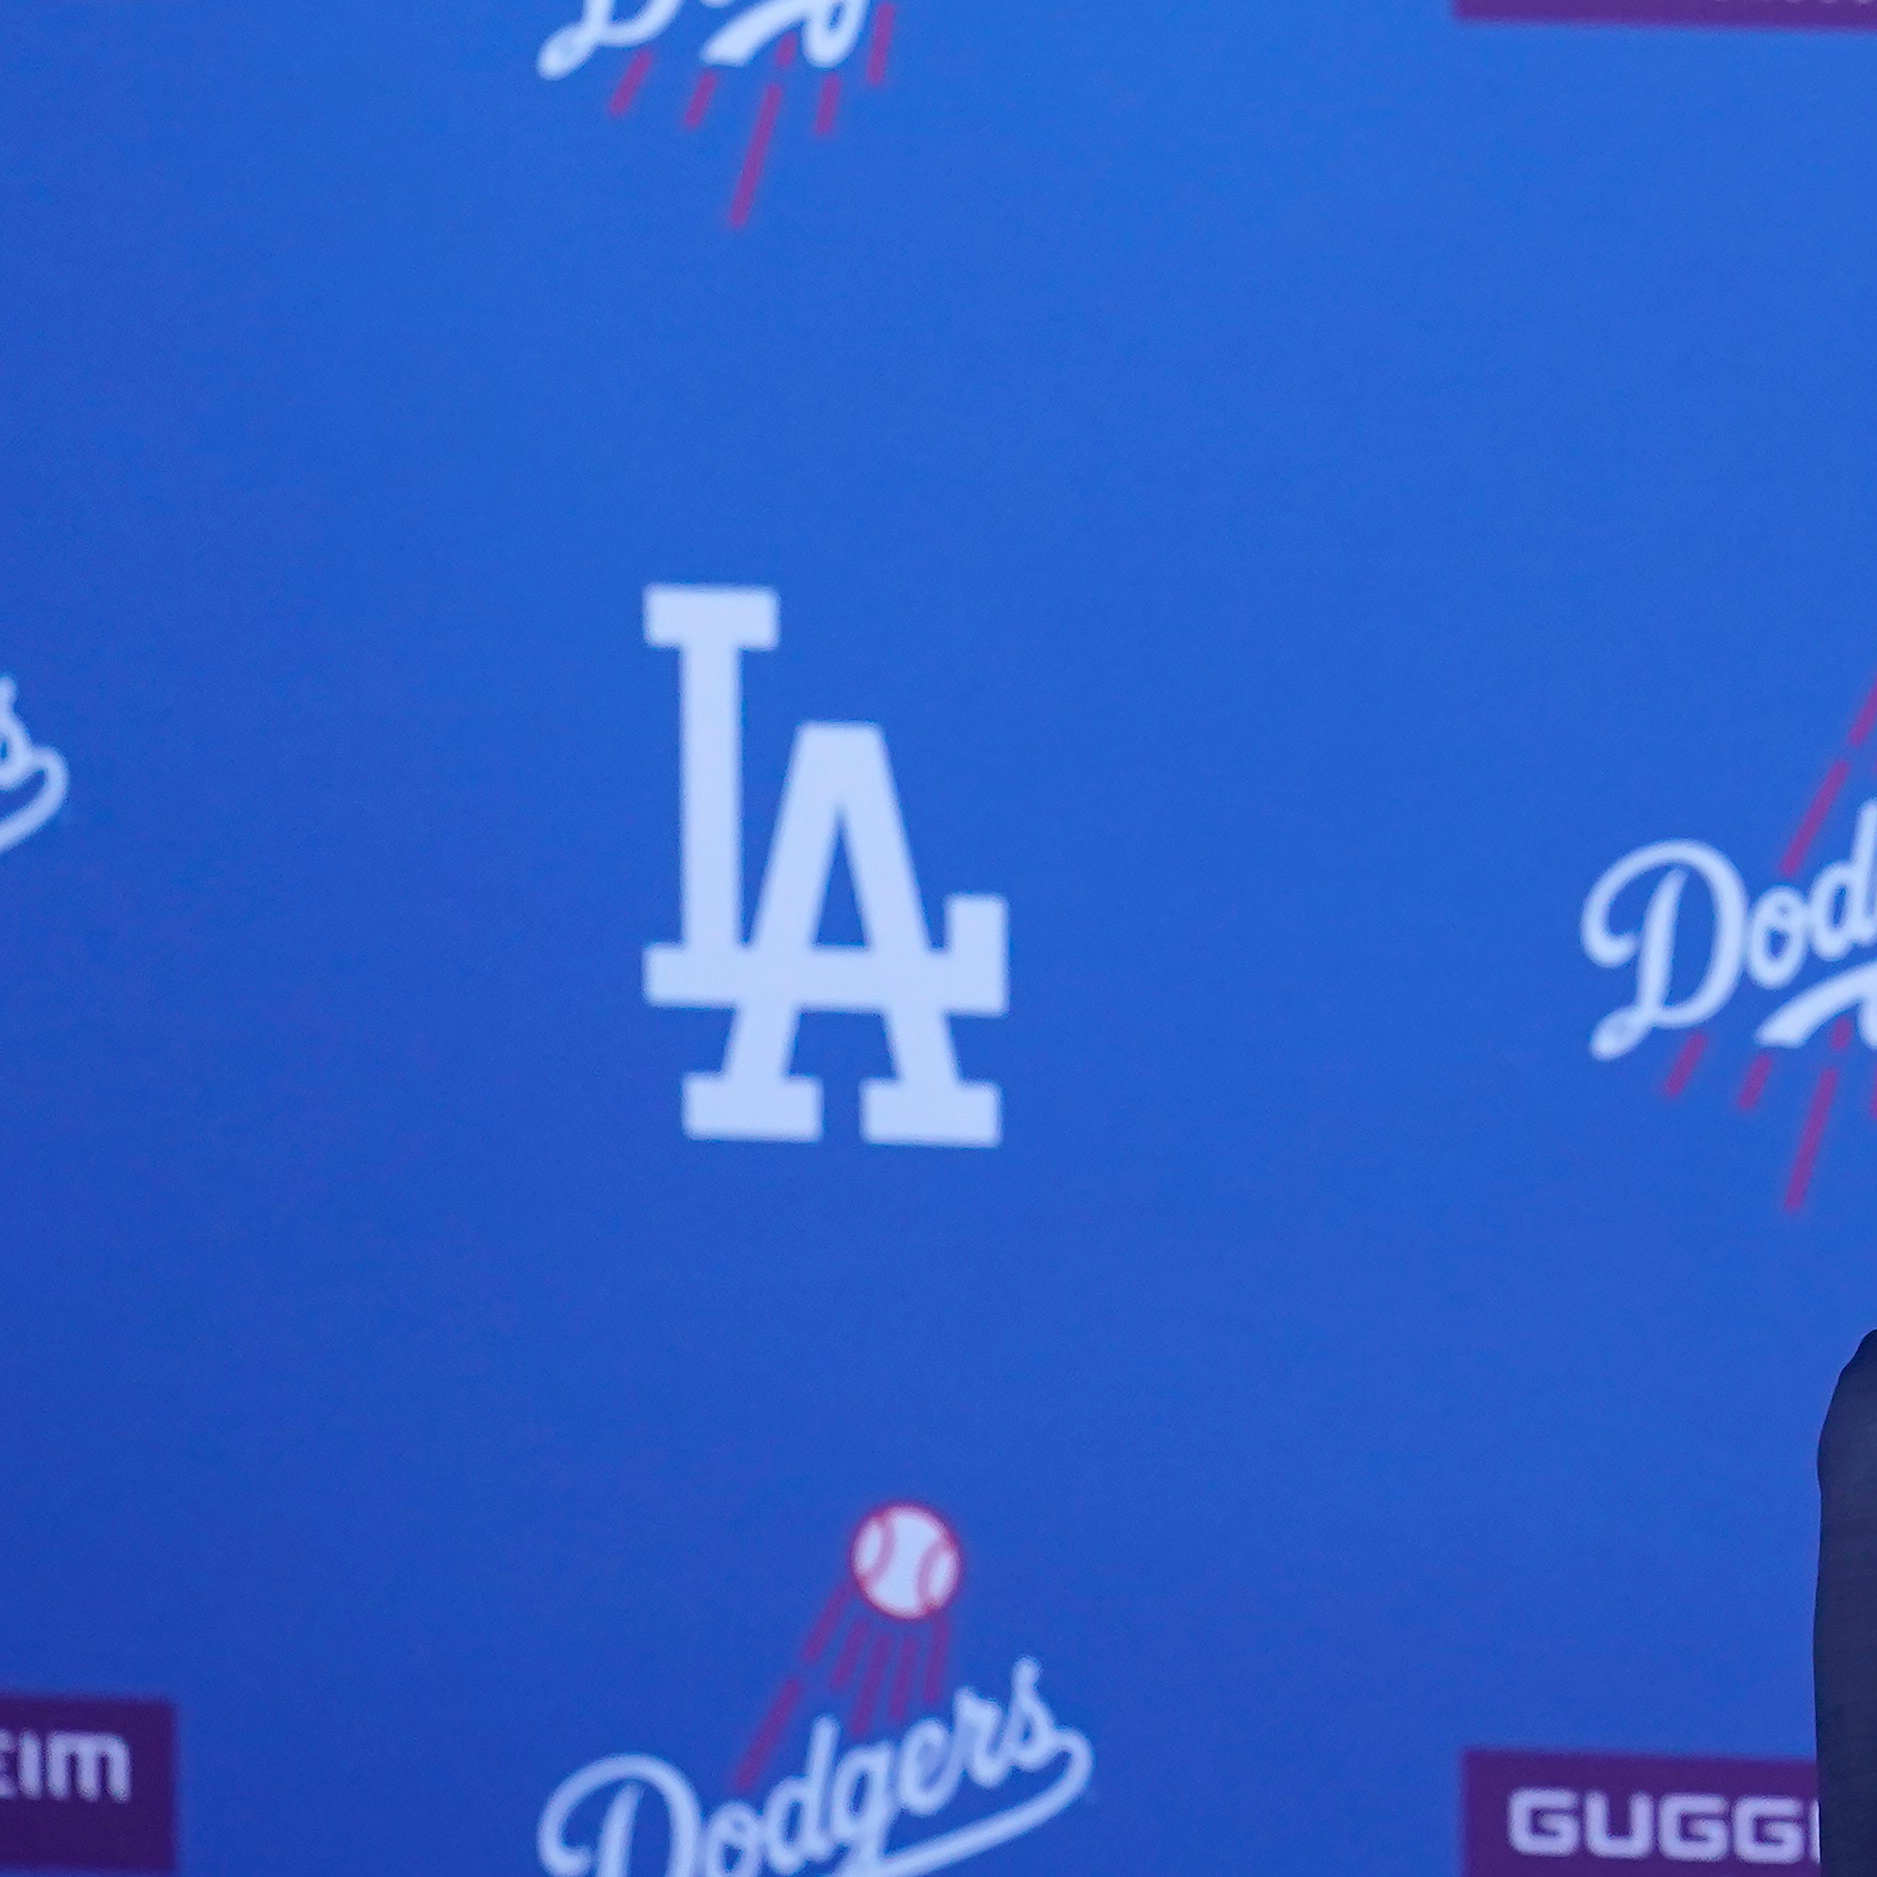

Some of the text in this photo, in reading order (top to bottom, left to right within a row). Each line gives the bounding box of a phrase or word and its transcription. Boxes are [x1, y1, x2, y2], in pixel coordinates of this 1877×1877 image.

[643, 584, 1008, 1147] LA
[0, 1730, 130, 1804] IM
[538, 1656, 1092, 1877] Dodgers
[1507, 1787, 1821, 1864] GUGG
